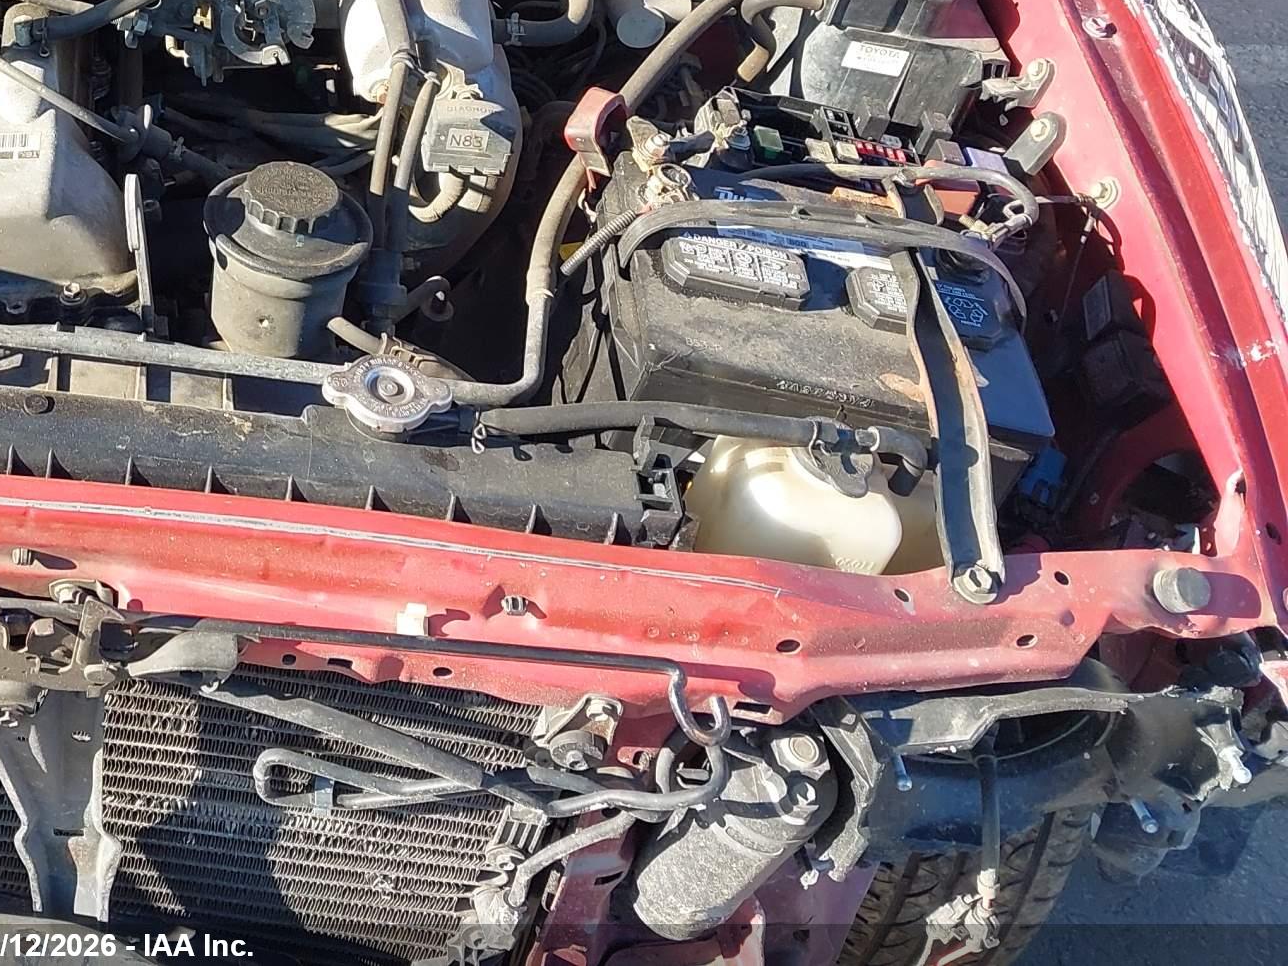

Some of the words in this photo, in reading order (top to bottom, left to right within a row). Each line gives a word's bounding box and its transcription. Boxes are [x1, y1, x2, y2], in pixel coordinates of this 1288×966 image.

[859, 44, 900, 58] TOYOTA
[693, 233, 738, 249] DANGER
[746, 243, 789, 260] POISON
